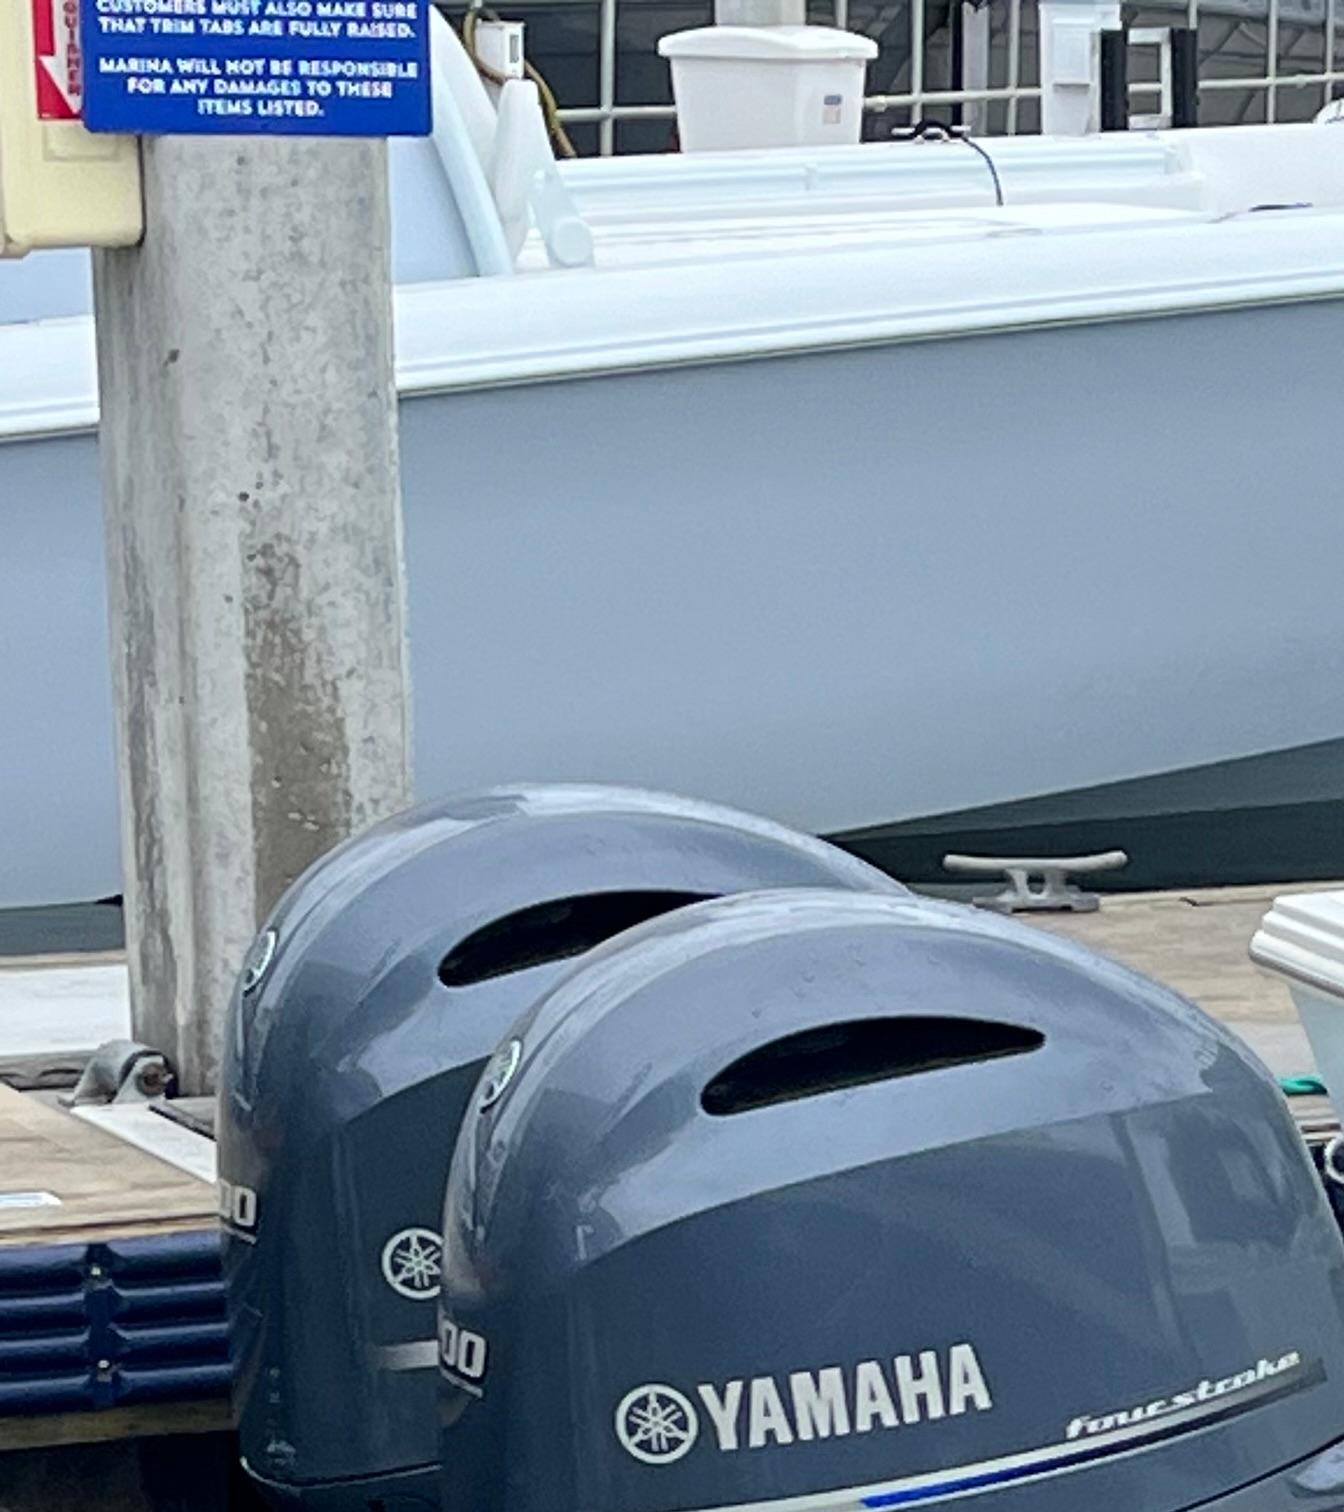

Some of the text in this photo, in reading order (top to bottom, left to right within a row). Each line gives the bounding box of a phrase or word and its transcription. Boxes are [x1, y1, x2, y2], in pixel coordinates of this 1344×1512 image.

[96, 0, 417, 19] CUSTOMERS MUST ALSO MAKE SURE
[98, 16, 416, 38] THAT TRIM TABS ARE FULLY RAISED.
[99, 57, 417, 78] MARINA WILL NOT BE RESPONSIBLE
[127, 76, 392, 98] FOR ANY DAMAGES TO THESE
[197, 98, 325, 117] ITEMS LISTED.
[698, 1342, 993, 1452] YAMAHA
[1064, 1350, 1301, 1440] fourstroke
